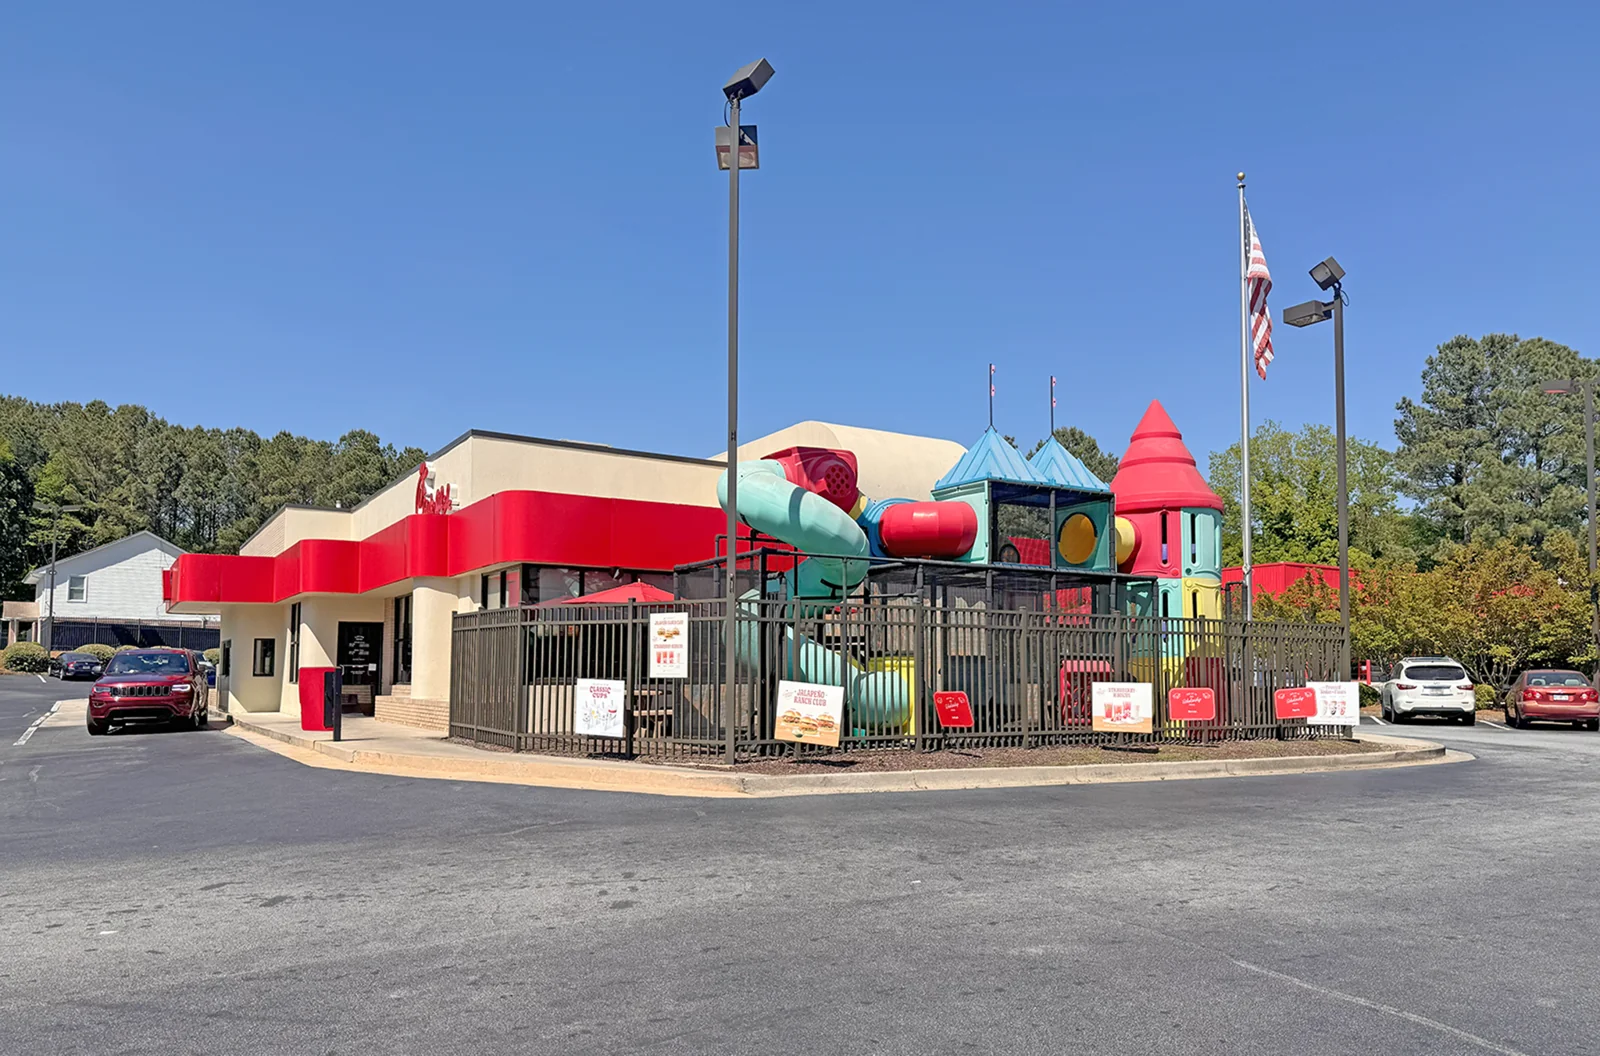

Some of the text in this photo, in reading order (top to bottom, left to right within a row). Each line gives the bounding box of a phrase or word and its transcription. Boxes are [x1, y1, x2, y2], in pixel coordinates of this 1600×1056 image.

[589, 685, 612, 695] CLASSIC
[796, 688, 826, 699] JALAPEÑO
[793, 695, 827, 707] RANCH CLUB
